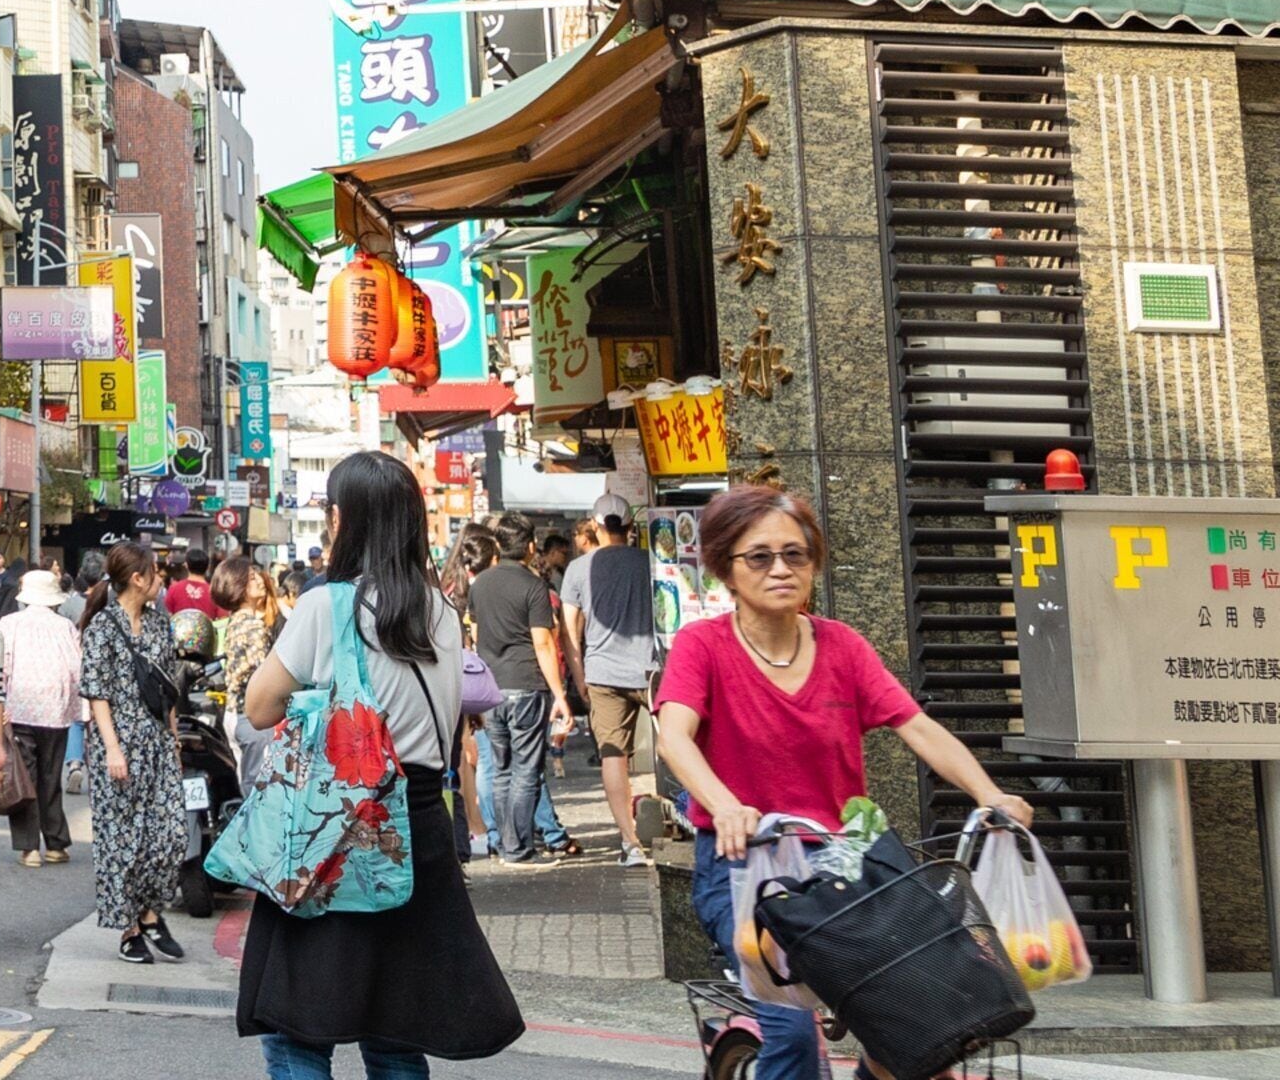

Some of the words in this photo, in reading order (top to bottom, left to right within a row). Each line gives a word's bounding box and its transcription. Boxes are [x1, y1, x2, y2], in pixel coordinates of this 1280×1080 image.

[337, 61, 354, 107] TARO
[340, 115, 357, 162] KING
[99, 371, 117, 412] 百貨
[135, 517, 165, 529] Clarks
[1228, 529, 1277, 552] 尚有
[1016, 524, 1059, 588] P
[1108, 525, 1170, 590] P
[1231, 567, 1280, 590] 車位
[1197, 605, 1267, 630] 公用停
[1164, 657, 1280, 681] 本建物依台北市建築
[1173, 699, 1280, 725] 鼓勵要點地下貳層
